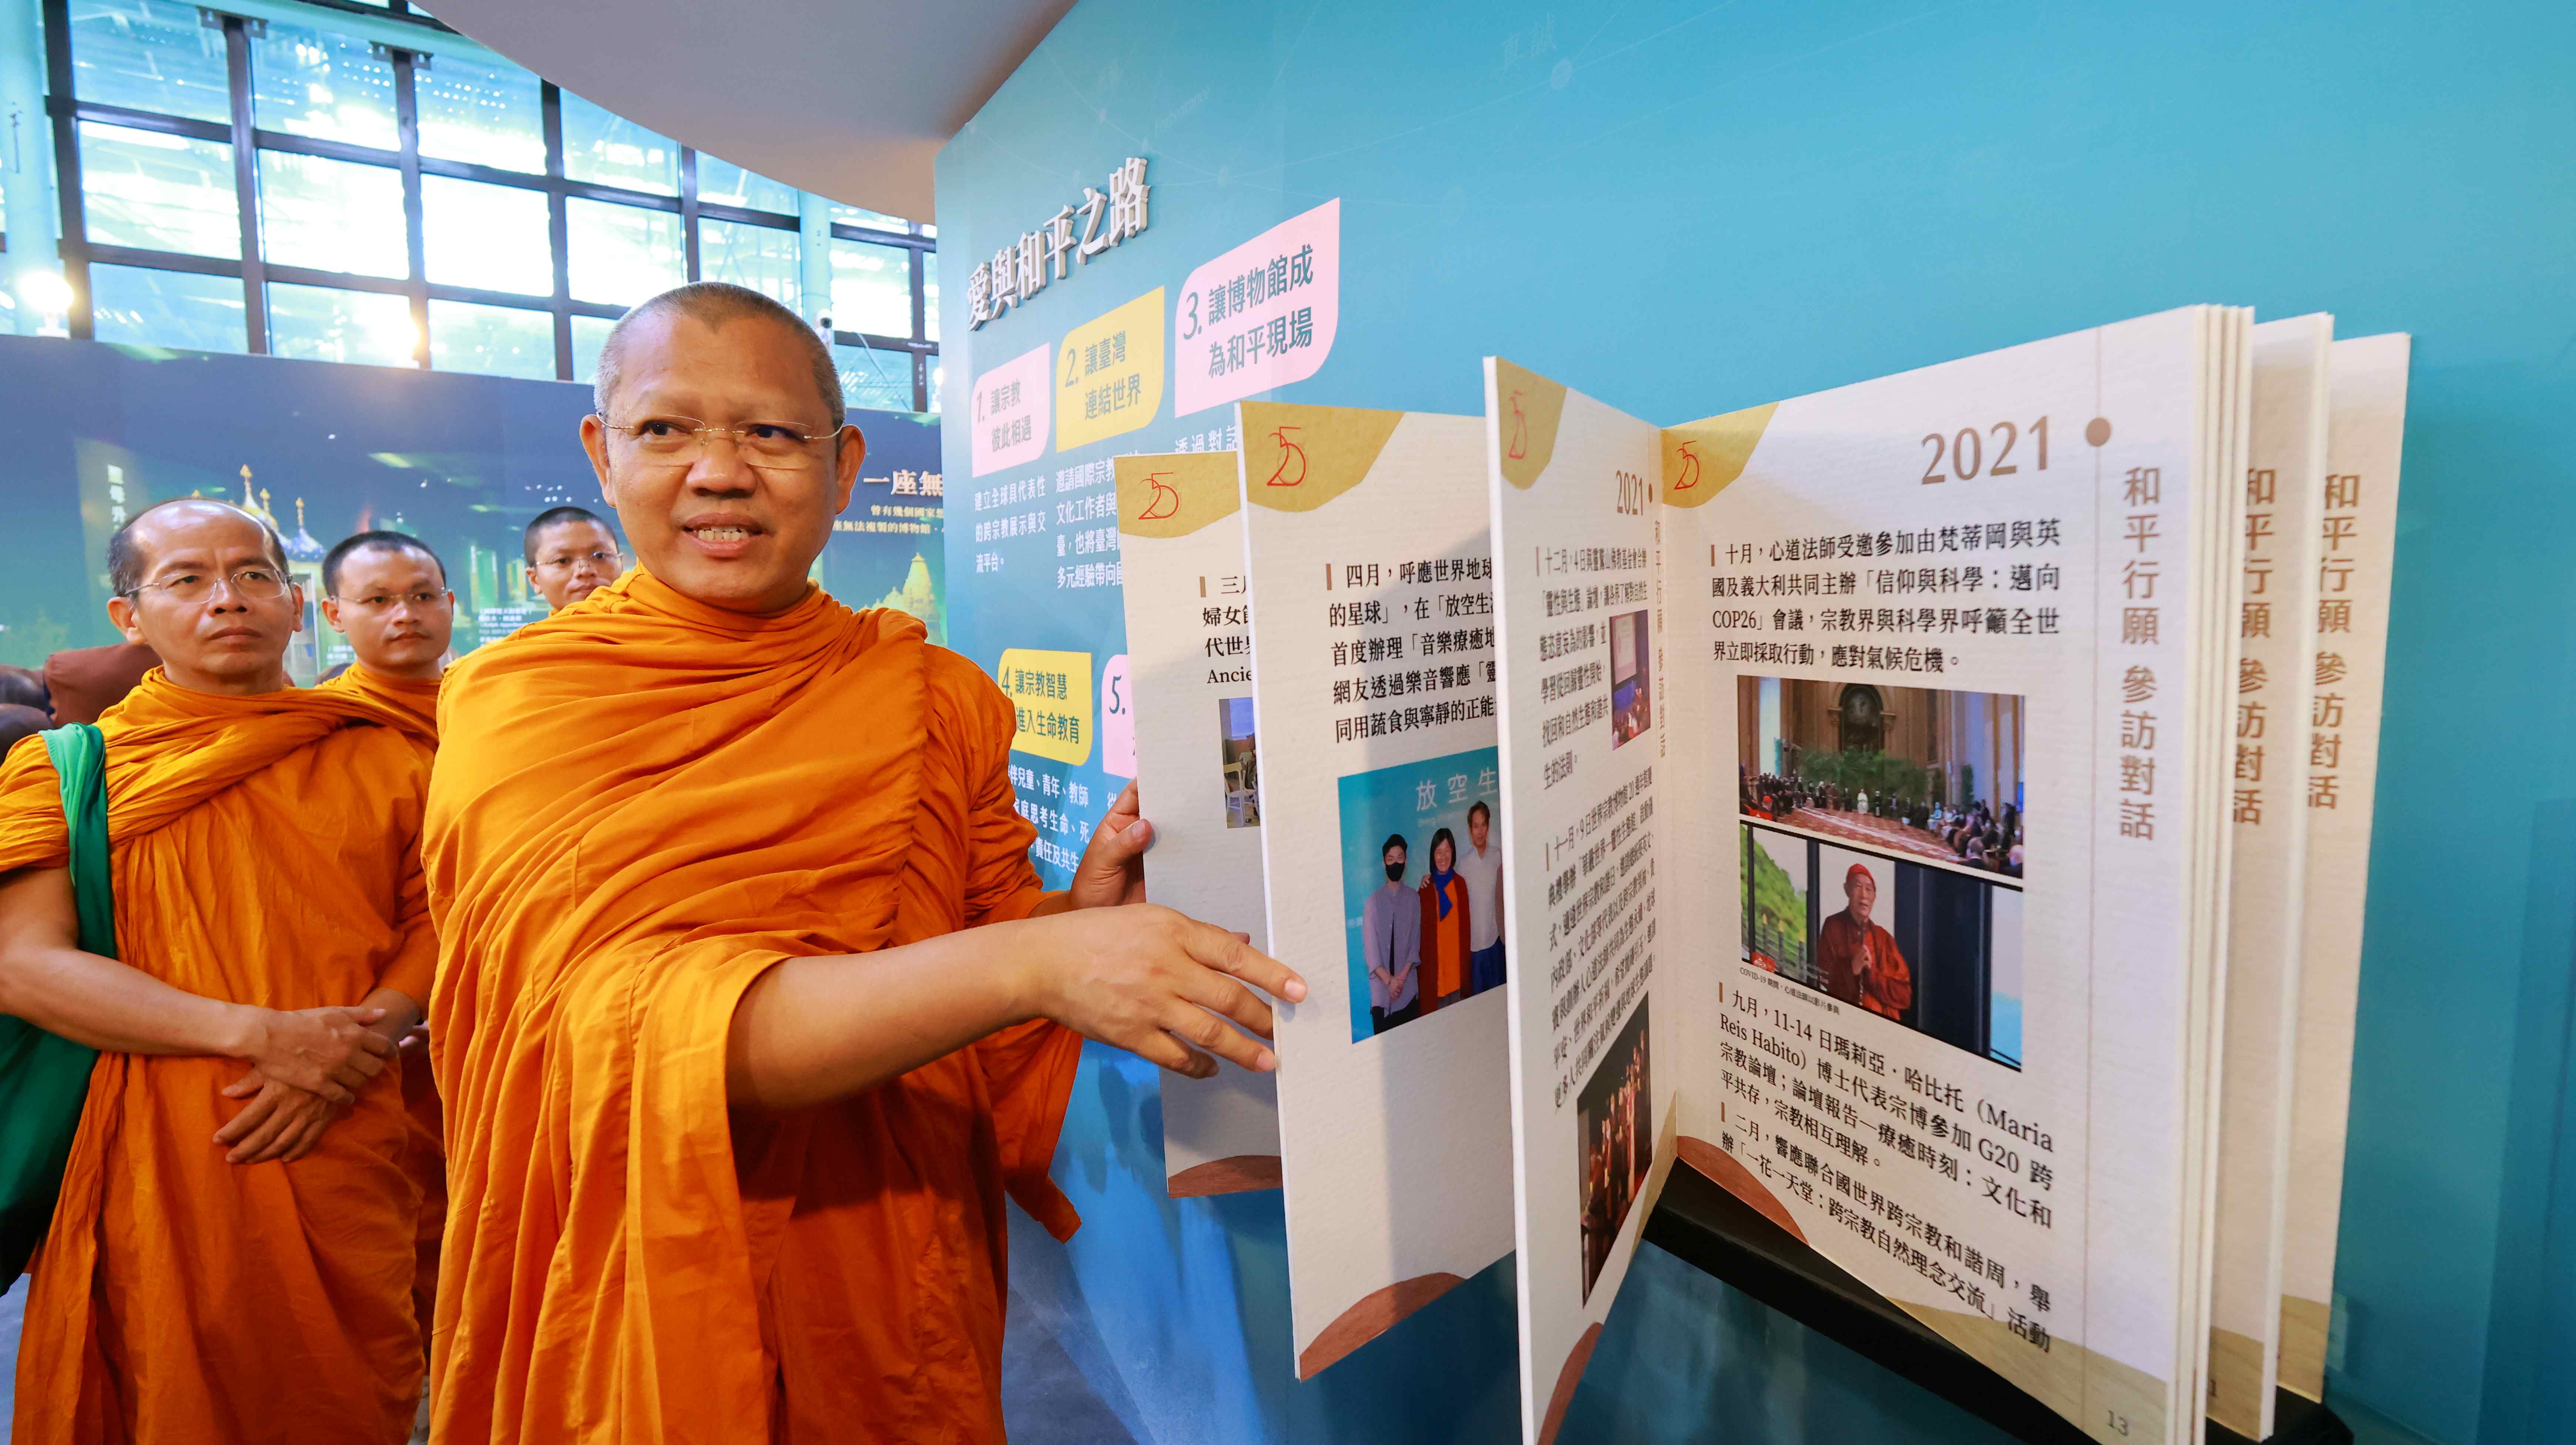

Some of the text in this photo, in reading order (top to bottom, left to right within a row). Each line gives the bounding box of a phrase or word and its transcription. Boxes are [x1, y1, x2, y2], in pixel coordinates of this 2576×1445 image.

[967, 157, 1150, 332] 愛與和平之路
[1183, 244, 1314, 340] 3. 讓博物館成
[1065, 330, 1126, 388] 2. 讓臺灣
[1208, 306, 1313, 379] 為和平現場
[976, 379, 1021, 423] 1. 讓宗教
[1084, 373, 1141, 421] 連結世界
[991, 415, 1032, 453] 彼此相遇
[1921, 416, 2049, 486] 2021
[974, 474, 1046, 512] 建立全球具代表性
[1616, 470, 1643, 516] 2021
[975, 509, 1046, 543] 的跨宗教展示與交
[1725, 518, 2061, 564] 十月，心道法師受邀參加由梵蒂岡與英
[1221, 576, 1246, 594] 三
[1329, 591, 1493, 628] 的星球」，在「放空生
[1713, 641, 1959, 673] 界立即採取行動，應對氣候危機。
[2119, 466, 2161, 841] 和平行願 參訪對話
[2308, 474, 2360, 809] 和平行願 參訪對話
[1002, 666, 1067, 700] 4. 讓宗教智慧
[1109, 674, 1126, 715] 5.
[1016, 707, 1080, 744] 進入生命教育
[1336, 695, 1497, 743] 同用蔬食與寧靜的正能
[1008, 765, 1089, 808] 伴兒童、青年、教師
[1031, 836, 1079, 873] 責任及共生
[1720, 1013, 1747, 1041] Reis
[1978, 1139, 2019, 1173] G20
[2029, 1159, 2053, 1191] 跨
[1721, 1069, 1880, 1166] 平共存，宗教相互理解。
[2107, 1410, 2129, 1436] 13
